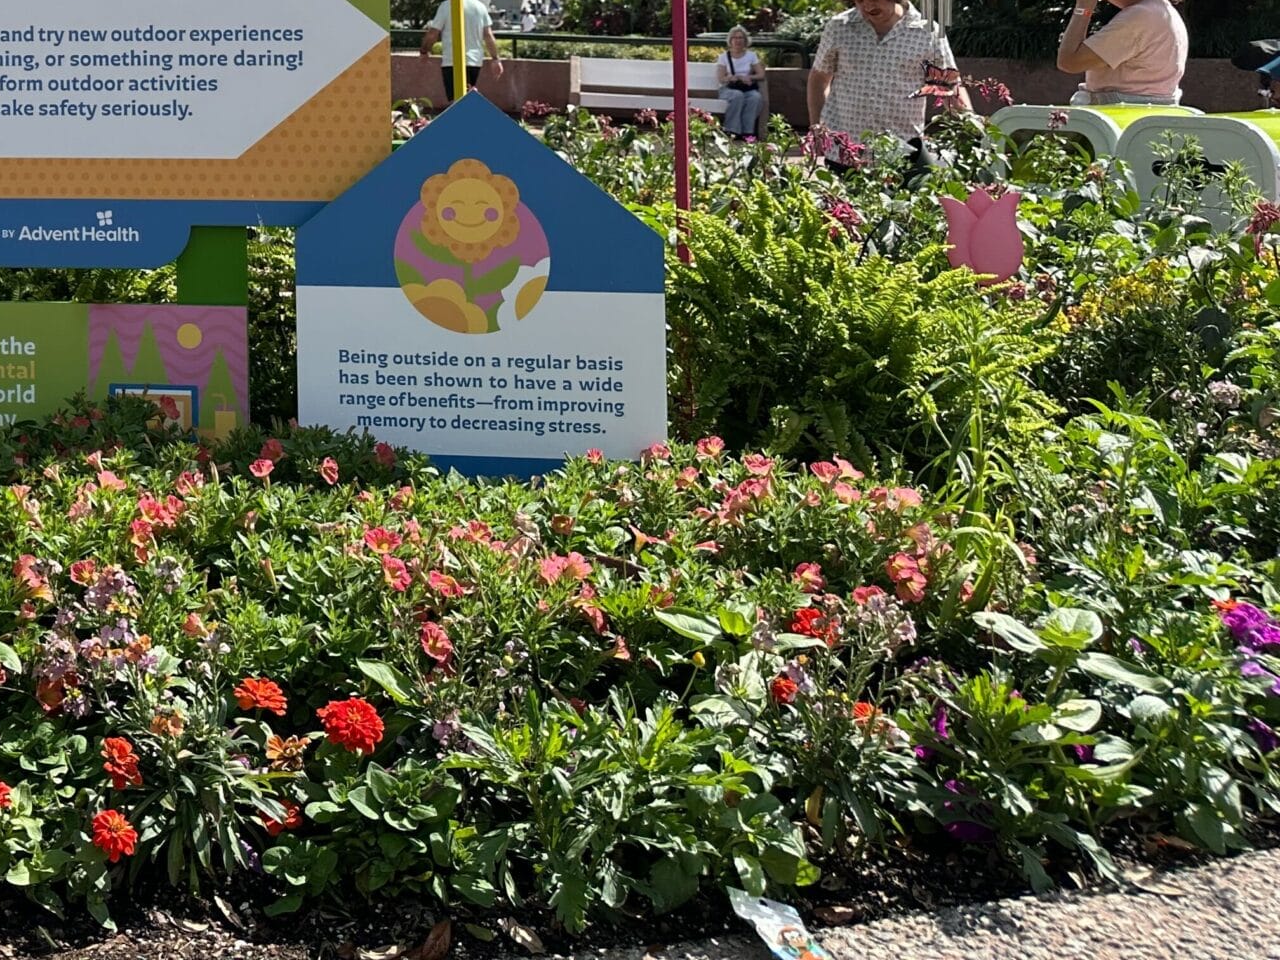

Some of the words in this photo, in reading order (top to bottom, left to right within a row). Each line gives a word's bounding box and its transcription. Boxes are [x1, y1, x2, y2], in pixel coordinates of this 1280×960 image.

[0, 25, 35, 43] and
[37, 27, 65, 47] try
[68, 29, 108, 42] new
[110, 24, 187, 42] outdoor
[189, 24, 304, 47] experiences
[44, 54, 65, 67] or
[70, 49, 174, 72] something
[178, 54, 228, 67] more
[233, 49, 304, 72] daring!
[47, 74, 125, 92] outdoor
[128, 74, 218, 92] activities
[38, 99, 98, 121] safety
[101, 99, 193, 121] seriously.
[1, 229, 16, 239] BY
[18, 225, 140, 242] AdventHealth
[0, 335, 36, 356] the
[338, 349, 389, 369] Being
[392, 351, 459, 367] outside
[463, 356, 486, 368] on
[491, 356, 501, 368] a
[507, 354, 571, 373] regular
[575, 354, 624, 371] basis
[339, 369, 370, 385] has
[375, 369, 418, 386] been
[423, 371, 483, 388] shown
[488, 375, 508, 389] to
[514, 374, 557, 391] have
[562, 379, 572, 391] a
[578, 376, 623, 393] wide
[339, 394, 386, 410] range
[388, 391, 407, 407] of
[537, 396, 625, 418] improving
[358, 416, 426, 431] memory
[428, 416, 447, 429] to
[450, 414, 546, 437] decreasing
[548, 420, 607, 434] stress.
